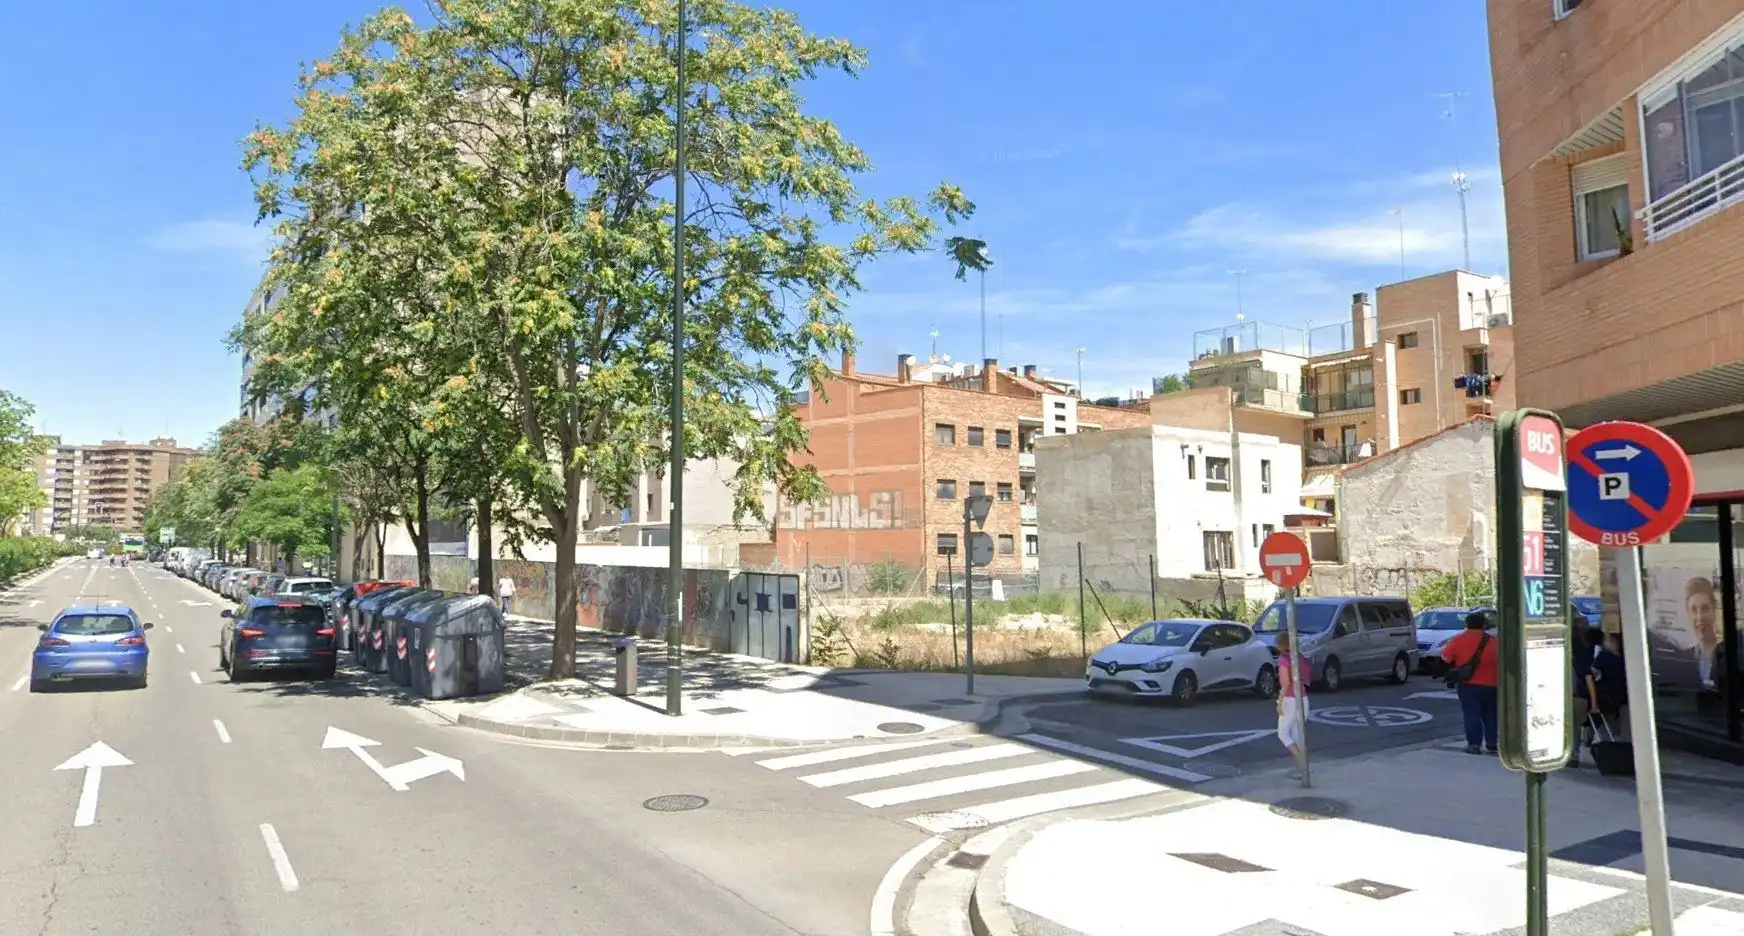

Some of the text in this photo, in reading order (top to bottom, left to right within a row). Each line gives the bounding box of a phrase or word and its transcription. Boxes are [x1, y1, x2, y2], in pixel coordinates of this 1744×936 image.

[1527, 430, 1555, 456] BUS
[1604, 477, 1621, 496] P
[1601, 532, 1641, 546] BUS
